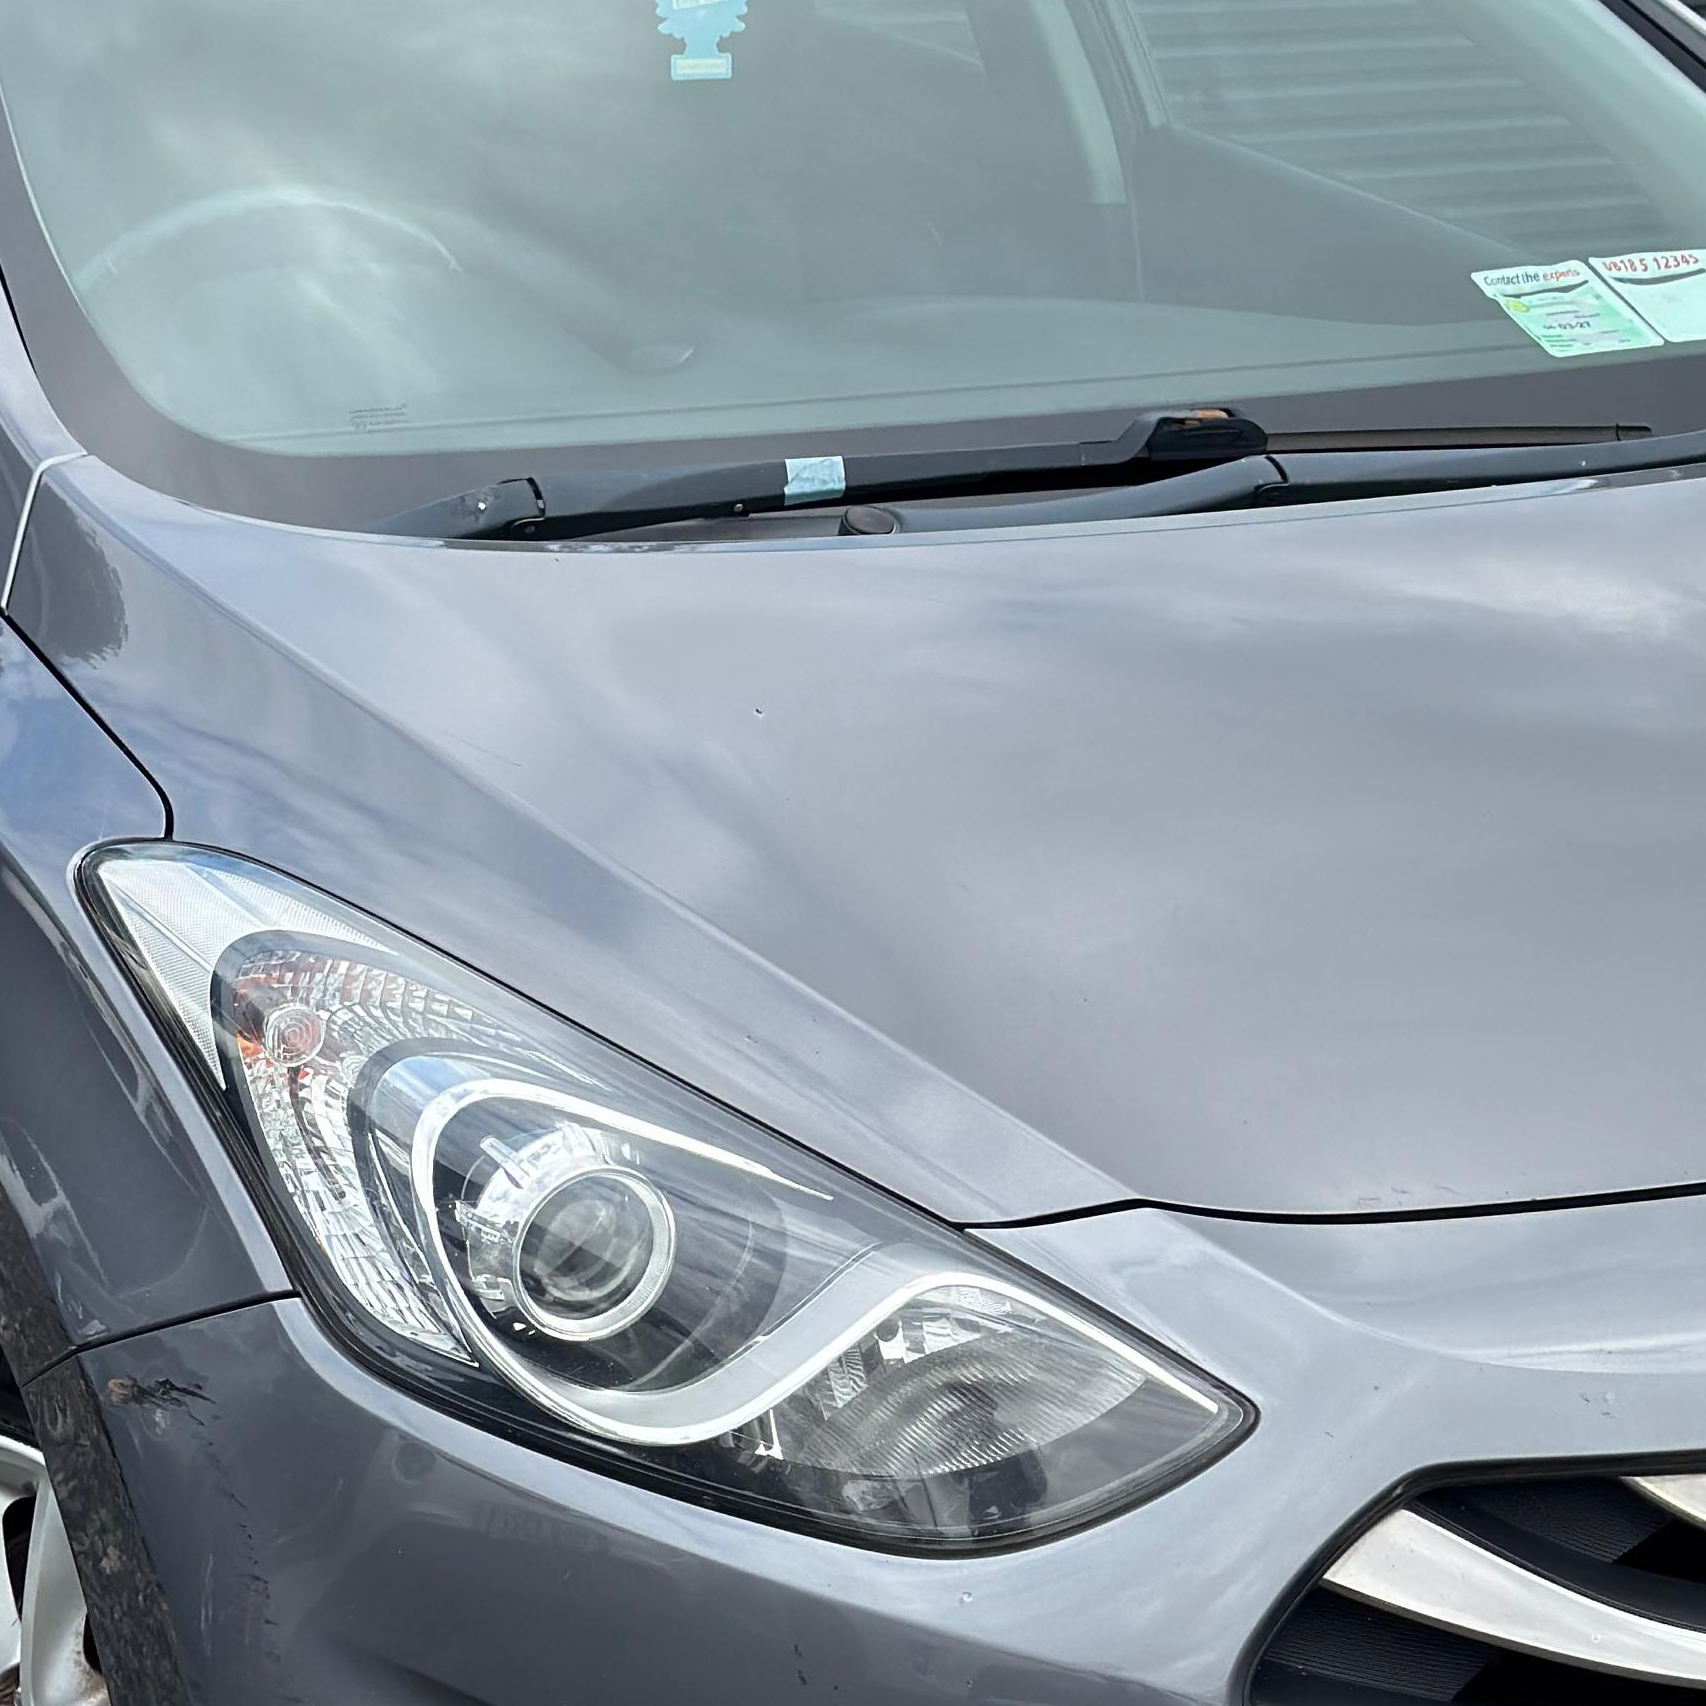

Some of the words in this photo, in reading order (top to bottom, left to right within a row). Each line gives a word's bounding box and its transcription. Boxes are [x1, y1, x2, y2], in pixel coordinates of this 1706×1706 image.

[1483, 273, 1520, 286] Contact
[1521, 271, 1541, 283] the
[1542, 269, 1581, 282] experts
